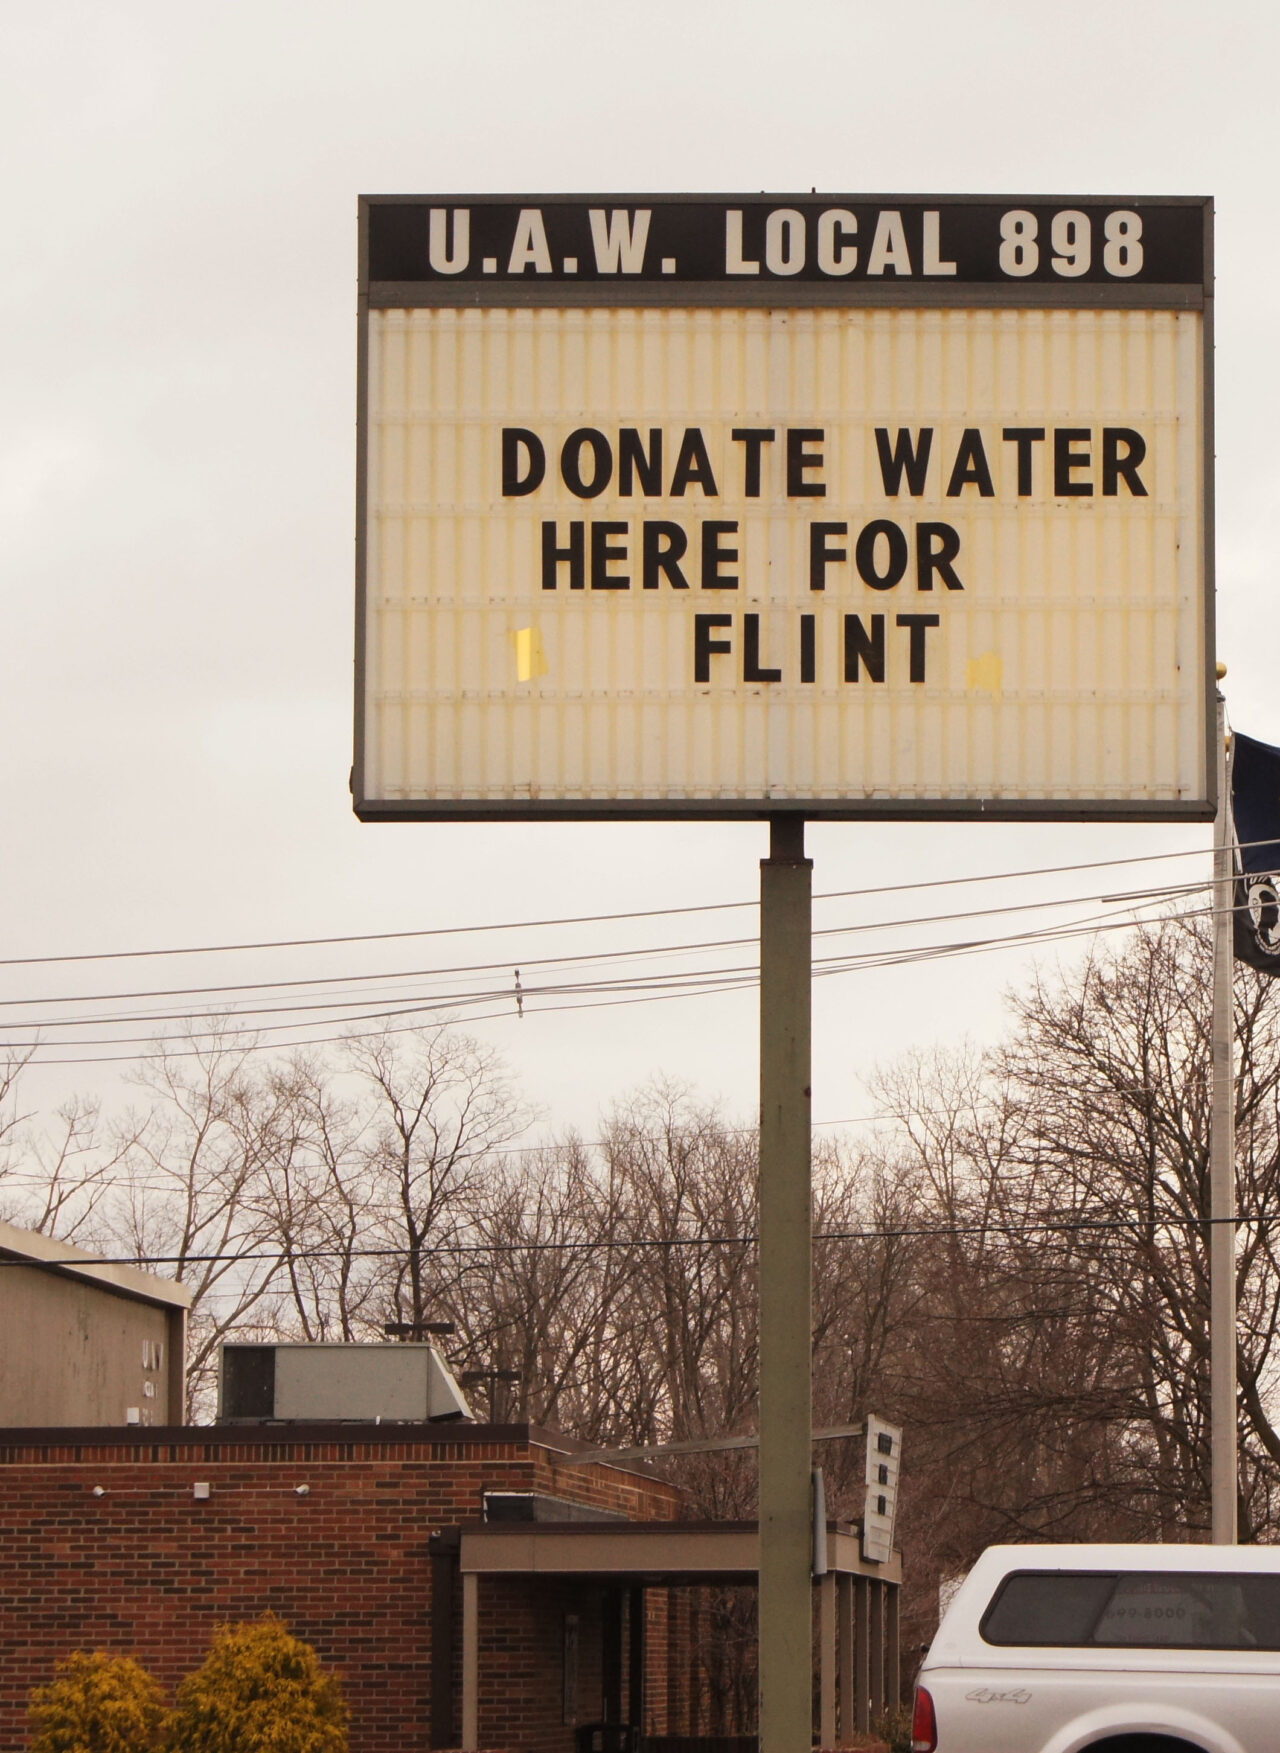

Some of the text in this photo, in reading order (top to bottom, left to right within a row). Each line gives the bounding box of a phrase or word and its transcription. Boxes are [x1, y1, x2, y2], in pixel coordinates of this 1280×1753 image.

[429, 208, 1144, 277] U.A.W. LOCAL 898
[501, 427, 1149, 500] DONATE WATER
[541, 519, 965, 592] HERE FOR
[694, 613, 940, 684] FLINT
